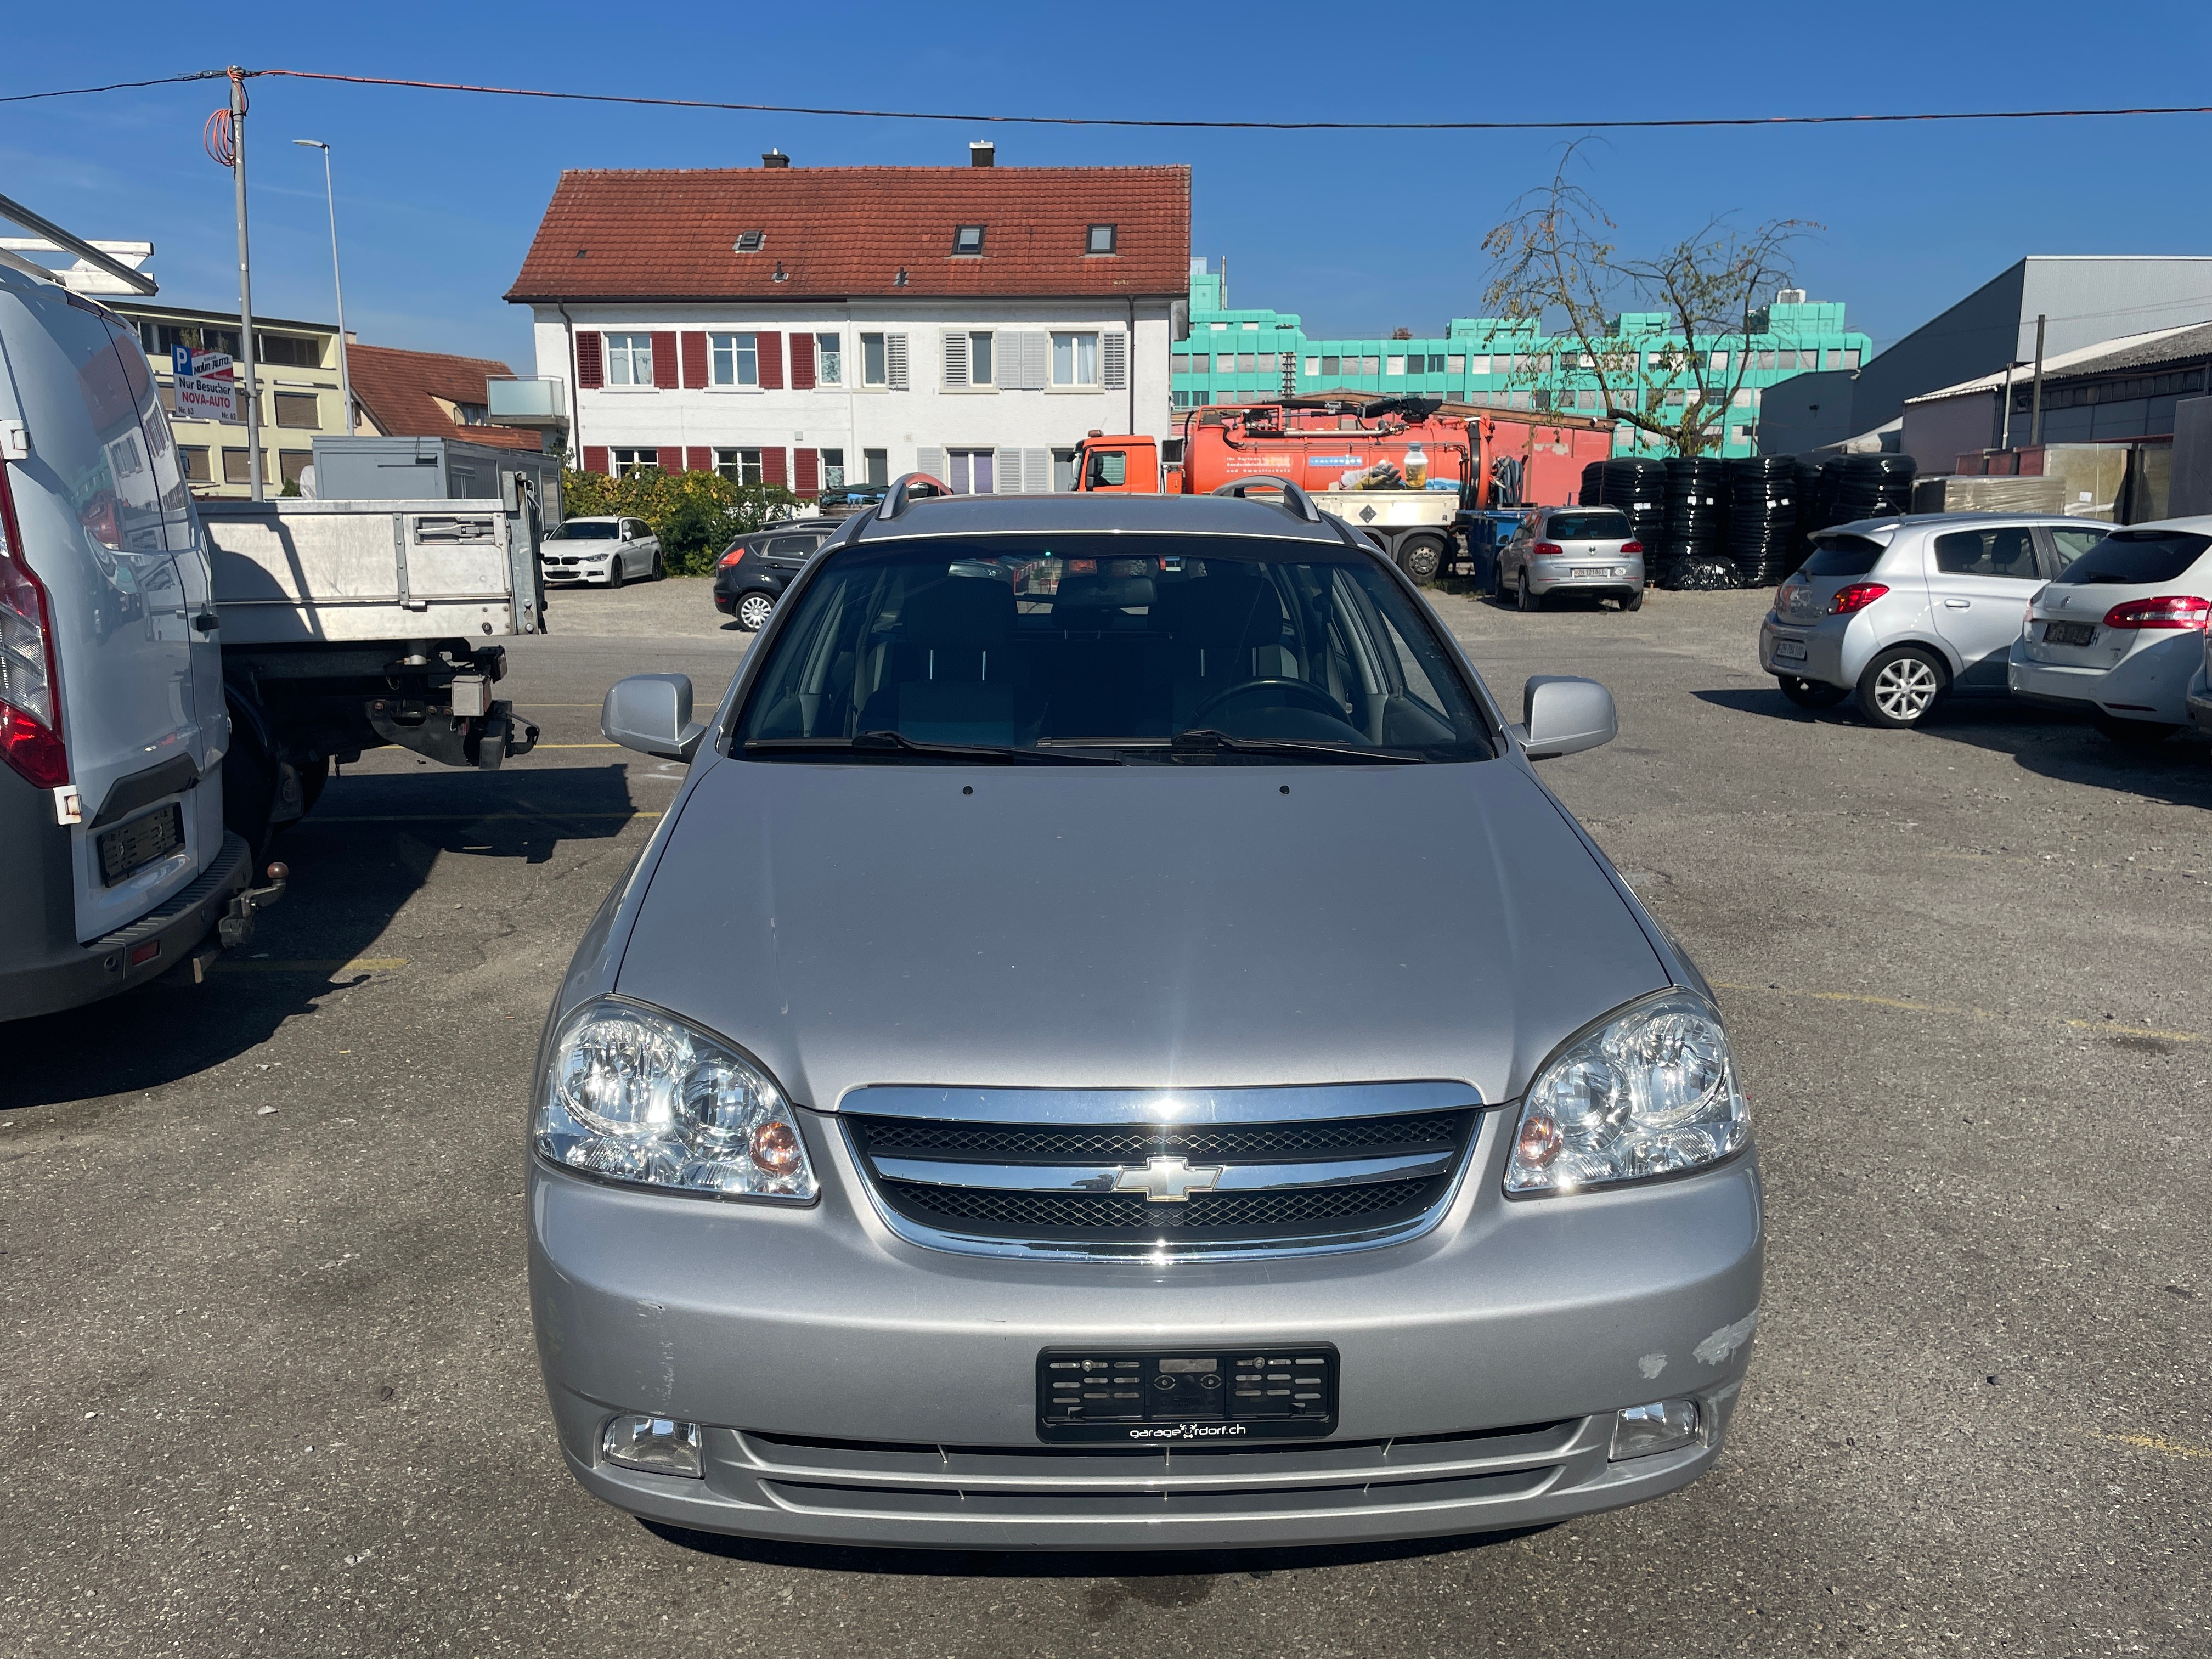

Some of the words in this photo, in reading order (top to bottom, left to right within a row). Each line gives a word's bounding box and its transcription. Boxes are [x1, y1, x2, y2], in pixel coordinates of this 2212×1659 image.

[176, 347, 187, 372] P
[179, 377, 194, 390] Nur
[196, 380, 230, 395] Besucher
[182, 391, 230, 408] NOVA-AUTO
